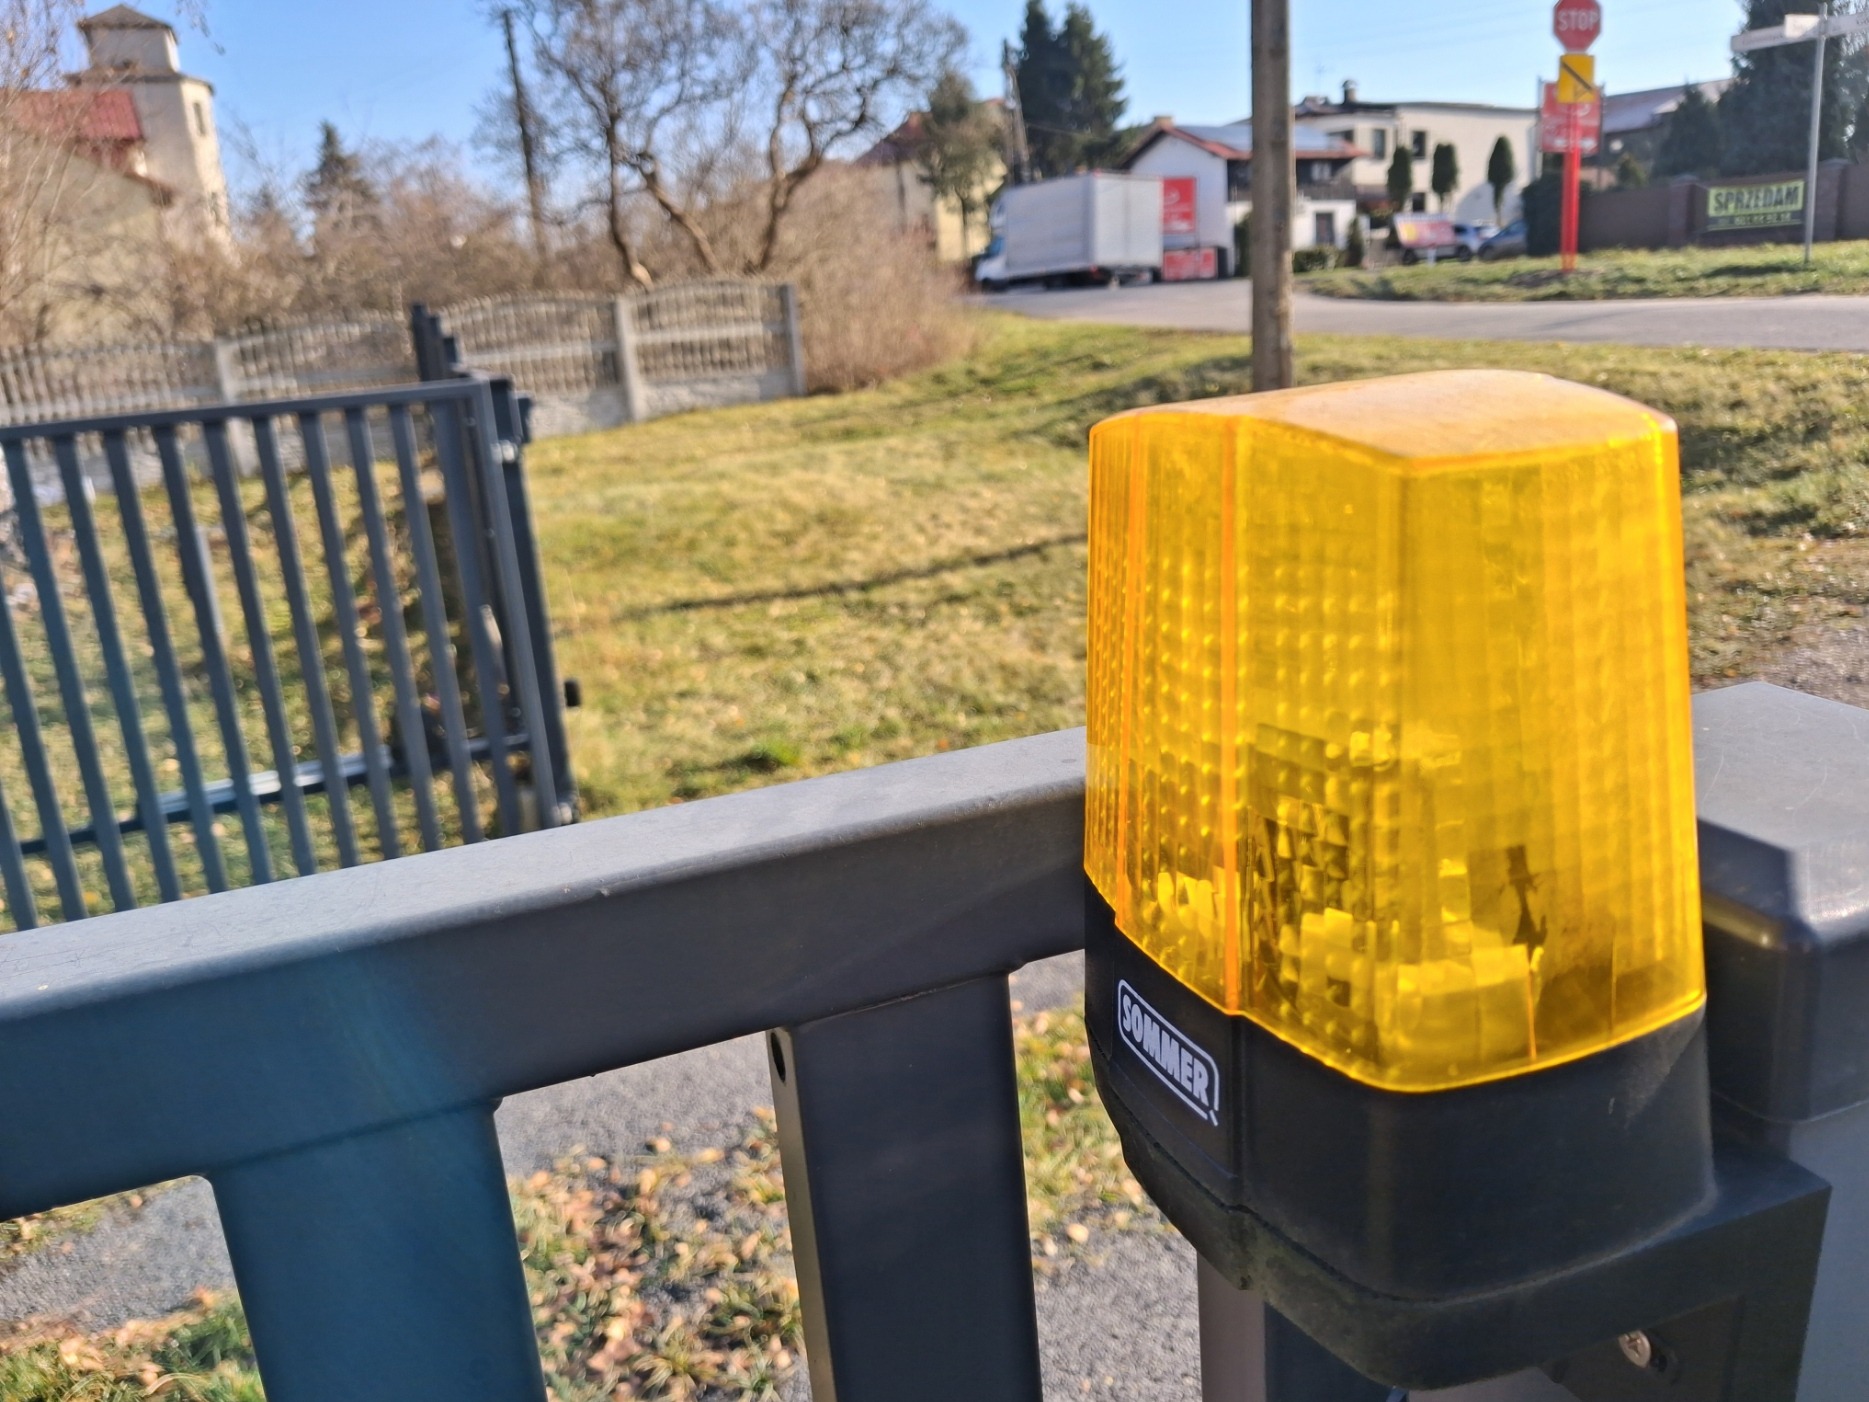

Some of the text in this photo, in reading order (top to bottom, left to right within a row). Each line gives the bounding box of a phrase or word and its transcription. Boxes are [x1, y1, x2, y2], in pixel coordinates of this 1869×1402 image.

[1558, 9, 1598, 31] STOP
[1714, 186, 1799, 212] SPRZEDAM
[1122, 994, 1209, 1107] SOMMER
